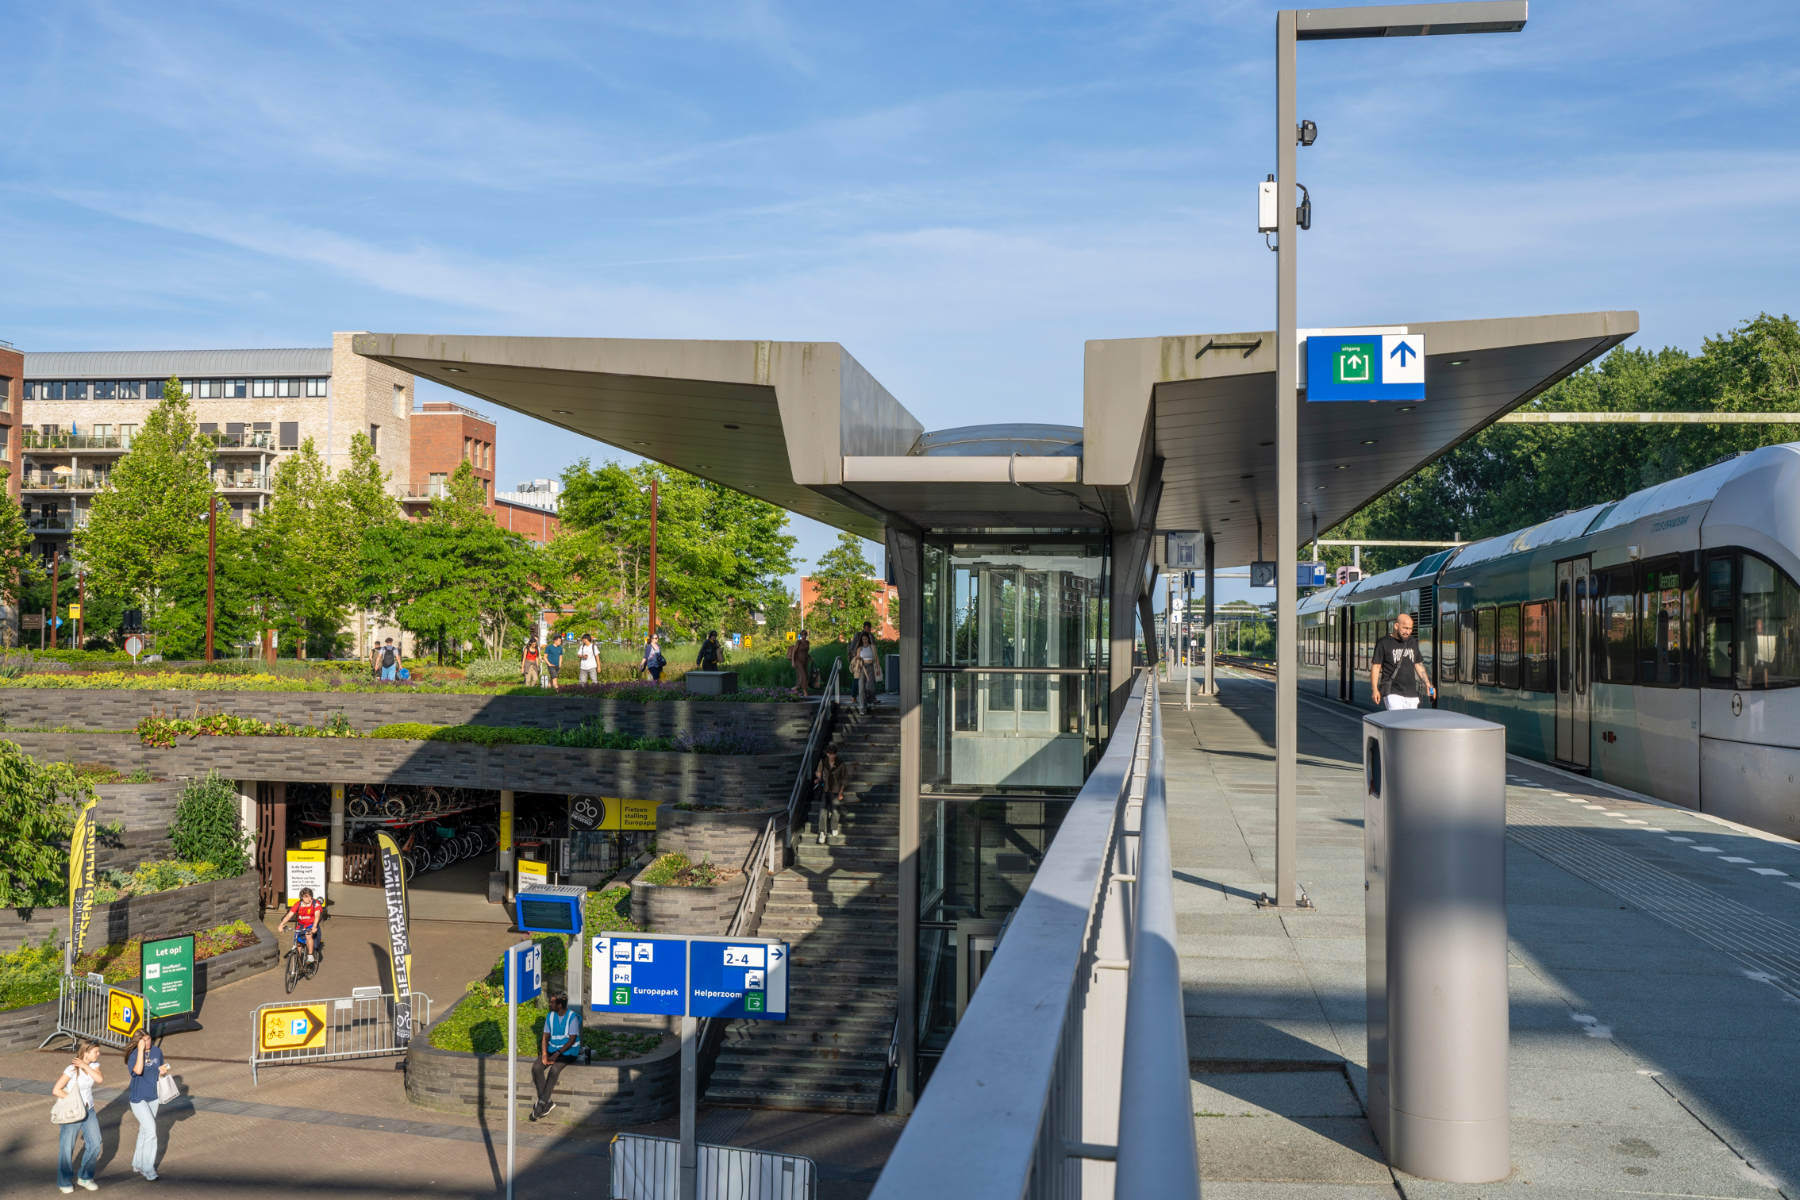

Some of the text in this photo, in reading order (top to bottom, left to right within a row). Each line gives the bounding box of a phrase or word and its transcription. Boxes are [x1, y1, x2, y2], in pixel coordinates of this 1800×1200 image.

[156, 945, 182, 956] Let op!
[614, 974, 630, 982] P+R
[634, 987, 679, 997] Europapark
[694, 989, 743, 998] Helperzoom
[123, 1006, 131, 1022] P
[292, 1019, 306, 1035] P
